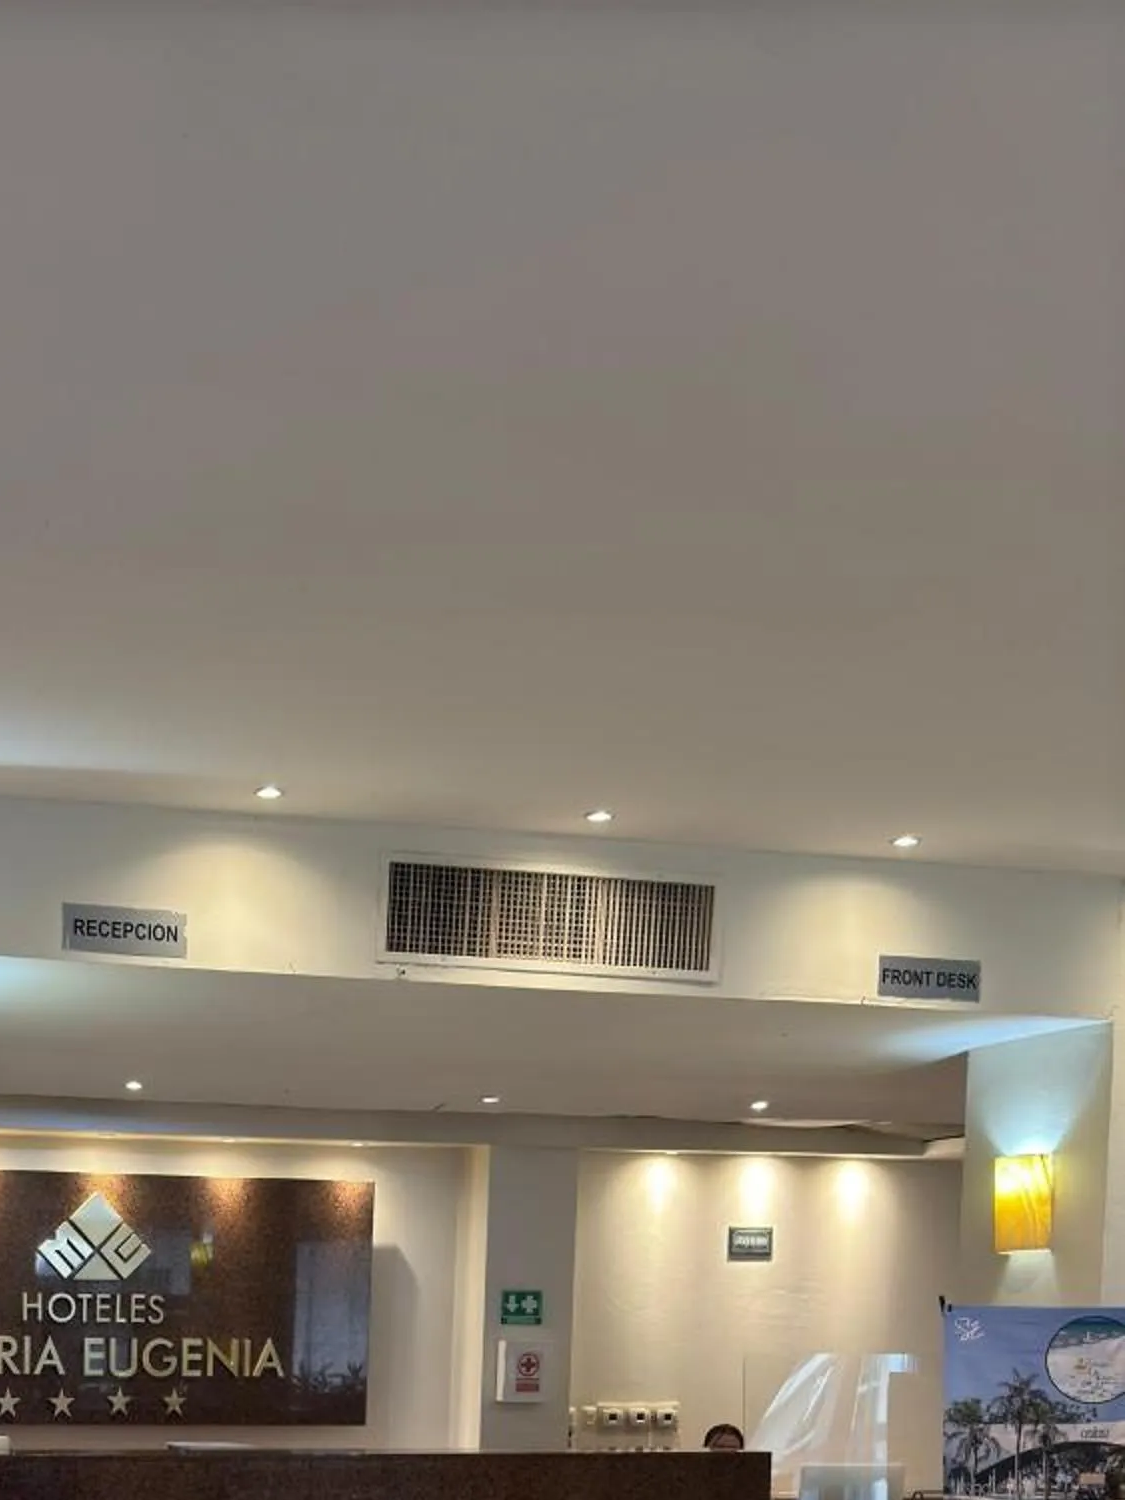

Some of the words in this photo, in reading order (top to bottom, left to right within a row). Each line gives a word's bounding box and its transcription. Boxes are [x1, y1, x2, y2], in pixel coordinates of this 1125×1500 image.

[73, 918, 178, 942] RECEPCION
[882, 968, 934, 988] FRONT
[936, 972, 978, 989] DESK
[21, 1291, 166, 1325] HOTELES
[83, 1336, 285, 1379] EUGENIA
